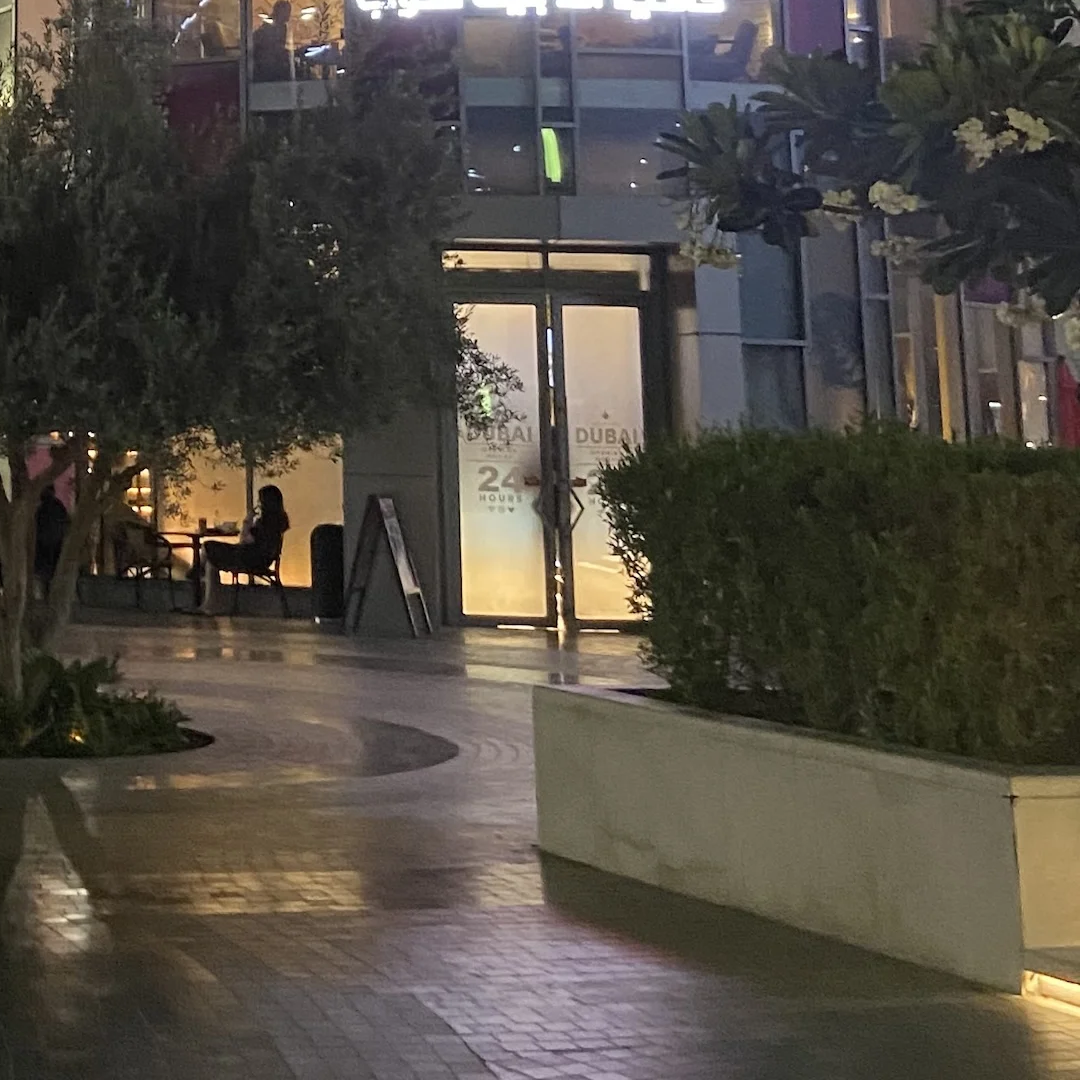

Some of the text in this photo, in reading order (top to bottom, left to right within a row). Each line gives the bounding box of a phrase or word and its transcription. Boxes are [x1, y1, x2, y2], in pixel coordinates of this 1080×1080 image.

[576, 426, 639, 445] DUBAI
[478, 466, 522, 492] 24
[479, 494, 523, 503] HOURS
